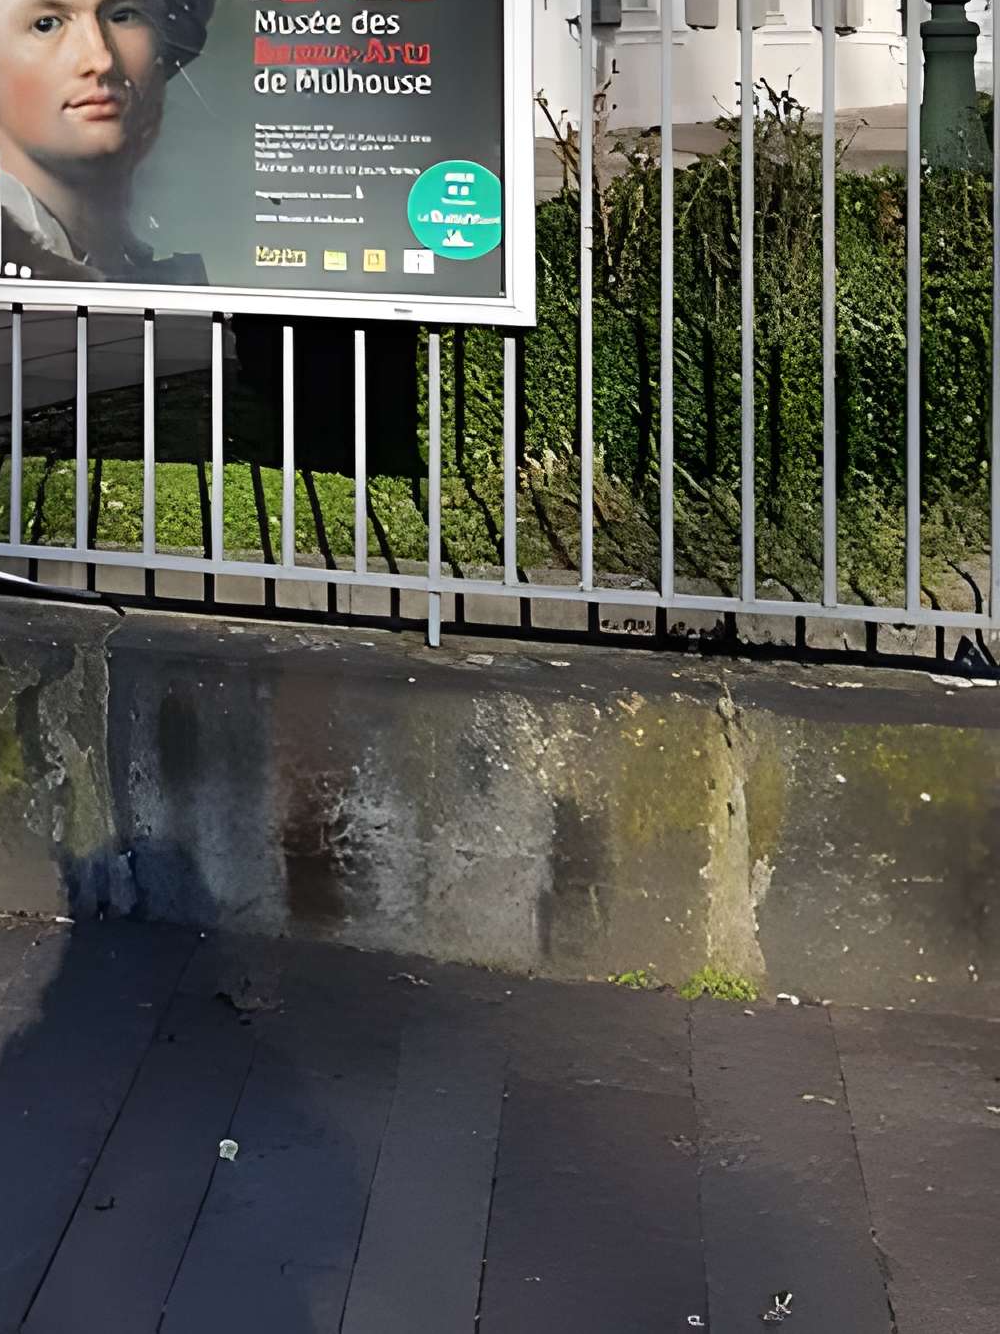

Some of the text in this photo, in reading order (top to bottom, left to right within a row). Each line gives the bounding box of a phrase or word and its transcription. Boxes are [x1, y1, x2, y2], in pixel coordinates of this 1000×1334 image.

[255, 10, 400, 35] Musée des
[253, 67, 432, 94] de Mulhouse
